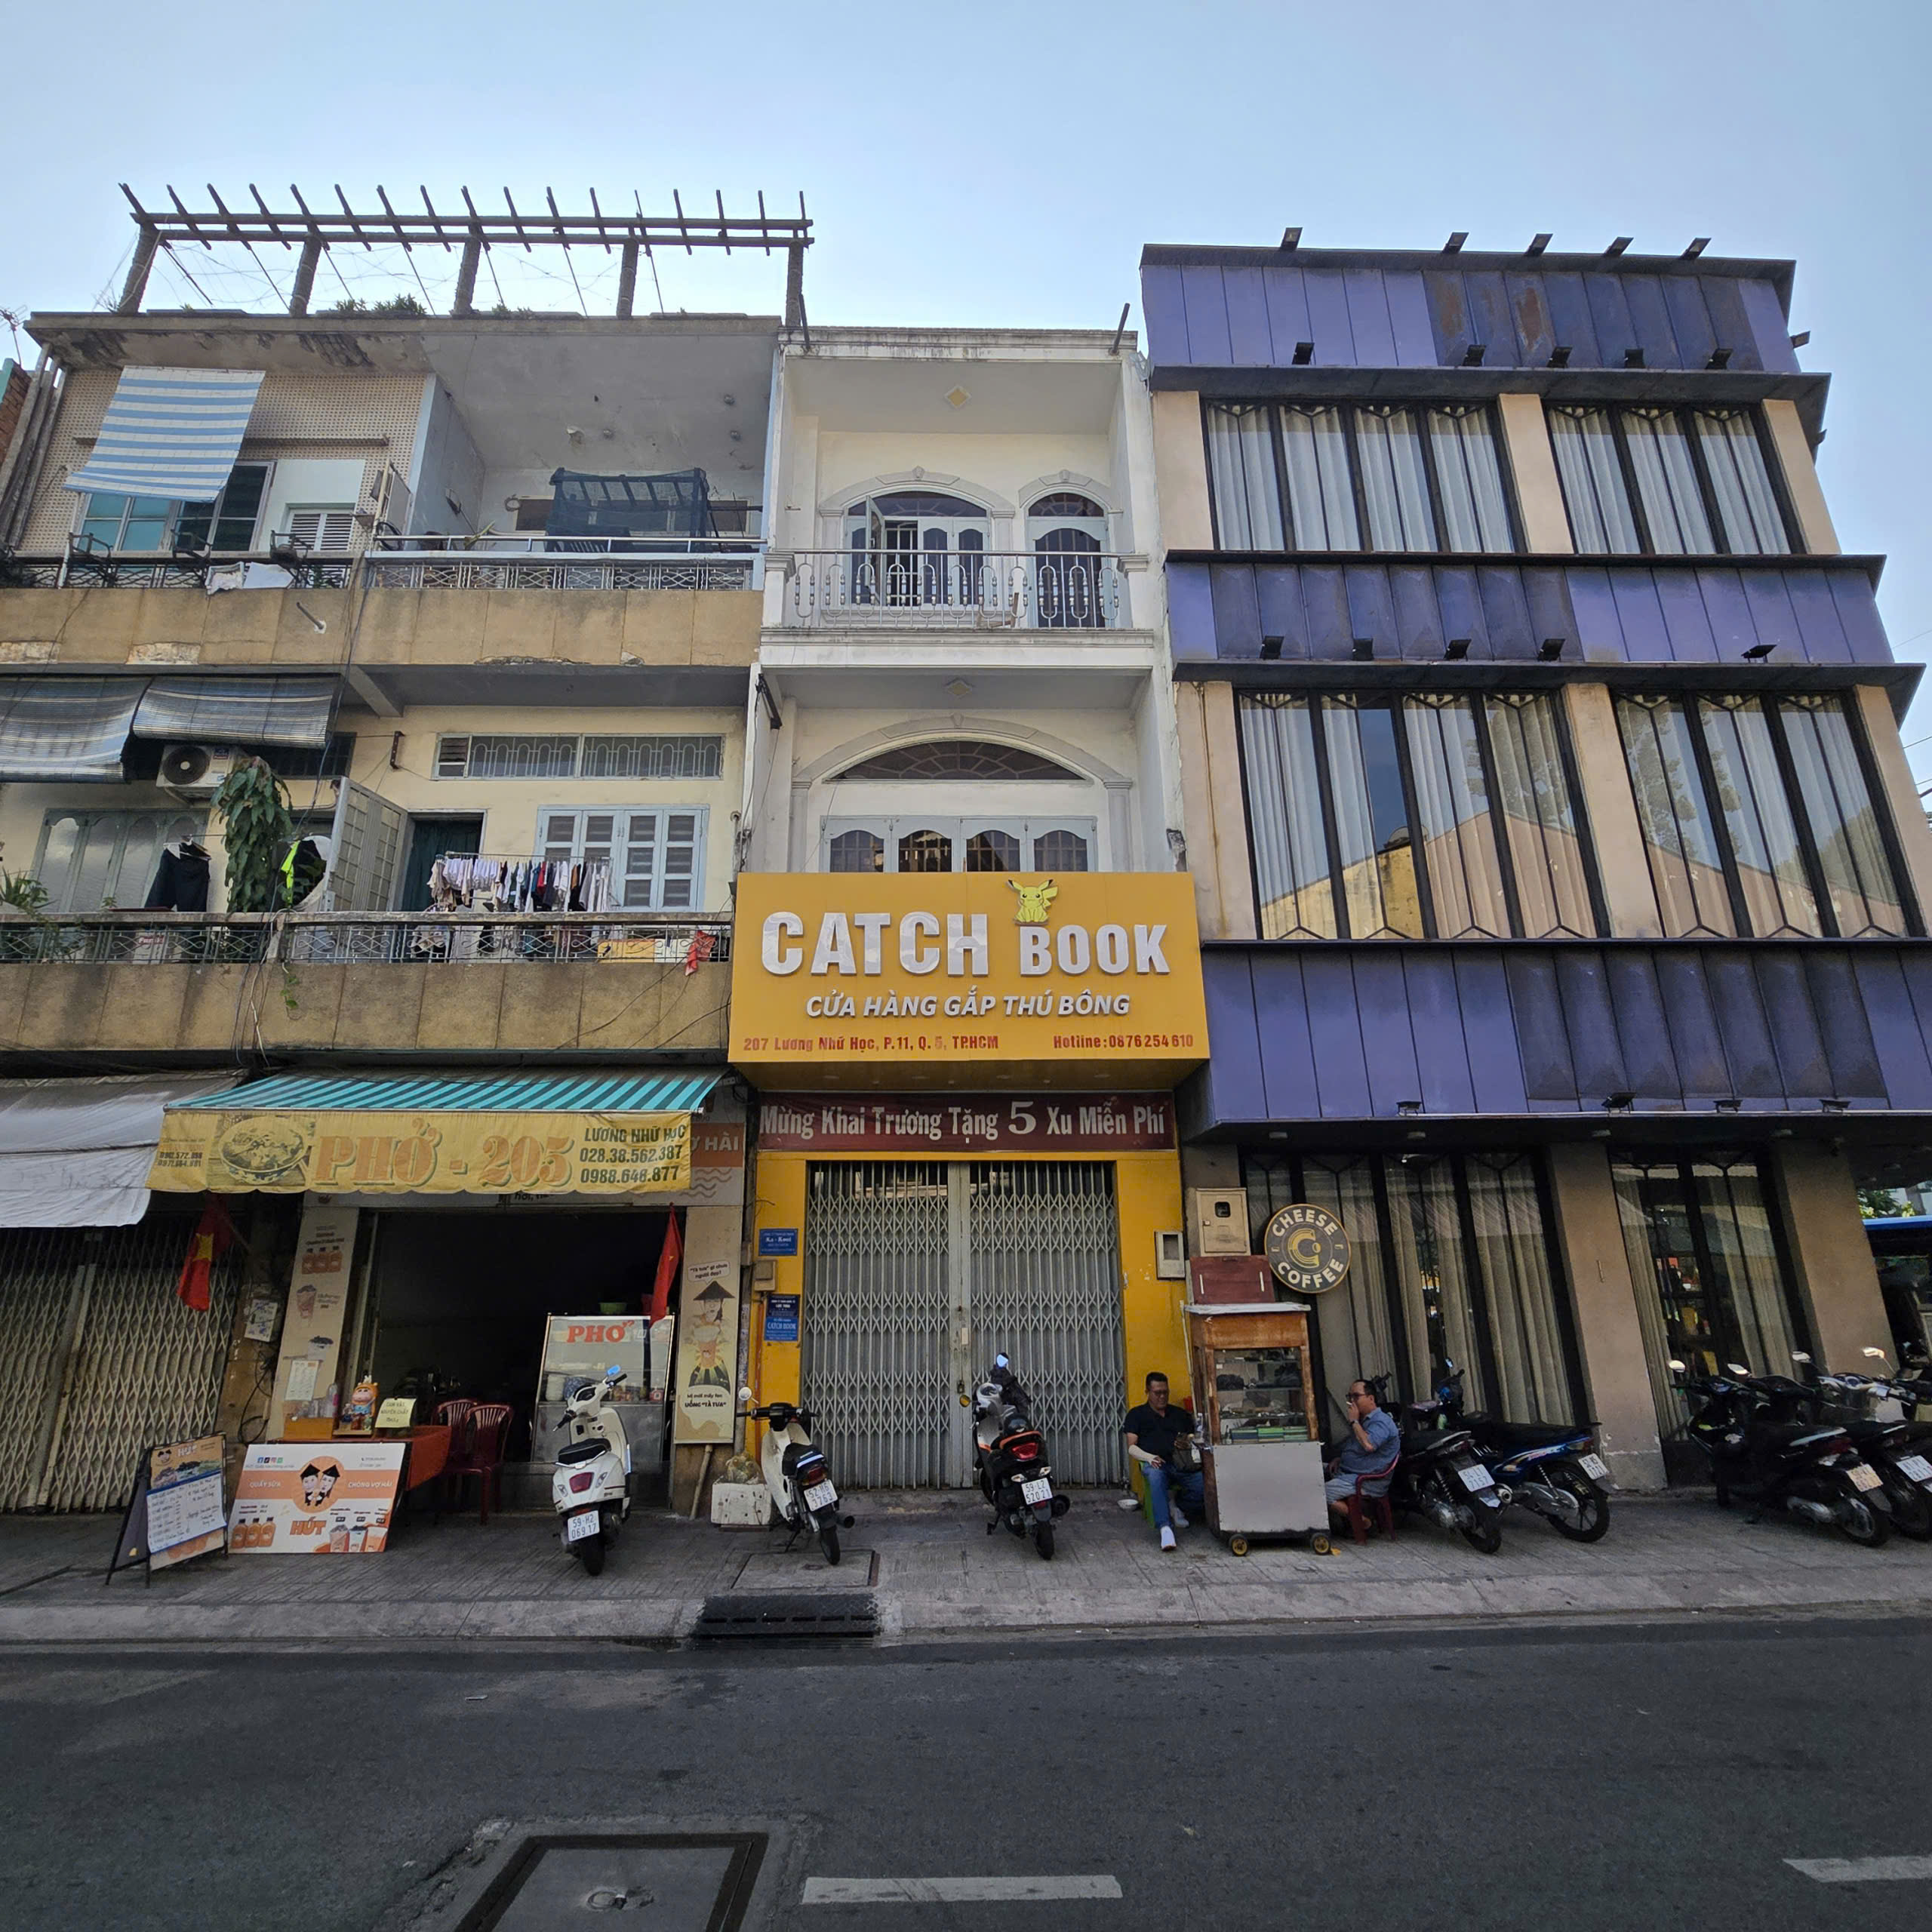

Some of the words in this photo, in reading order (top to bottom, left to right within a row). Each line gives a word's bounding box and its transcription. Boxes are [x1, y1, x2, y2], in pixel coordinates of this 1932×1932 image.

[761, 911, 988, 976] CATCH
[1019, 924, 1170, 976] BOOK
[806, 989, 855, 1017] CỬA
[863, 989, 937, 1017] HÀNG
[944, 984, 996, 1017] GẮP
[1003, 989, 1054, 1016] THÚ
[1058, 988, 1130, 1016] BÔNG
[743, 1037, 768, 1051] 207
[584, 1127, 627, 1142] LƯƠNG
[760, 1106, 814, 1140] Mừng
[822, 1106, 865, 1134] Khai
[872, 1106, 942, 1140] Trương
[949, 1106, 998, 1143] Tặng
[1008, 1101, 1037, 1134] 5
[1047, 1106, 1072, 1135] Xu
[1079, 1101, 1127, 1135] Miễn
[1133, 1106, 1164, 1134] Phí
[312, 1118, 442, 1187] PHỞ
[478, 1135, 575, 1187] 205
[579, 1144, 683, 1163] 028.38.562.387
[580, 1164, 680, 1183] 0988.648.877
[1272, 1209, 1338, 1236] CHEESE
[1278, 1259, 1343, 1287] COFFEE
[290, 1516, 327, 1536] HÚT
